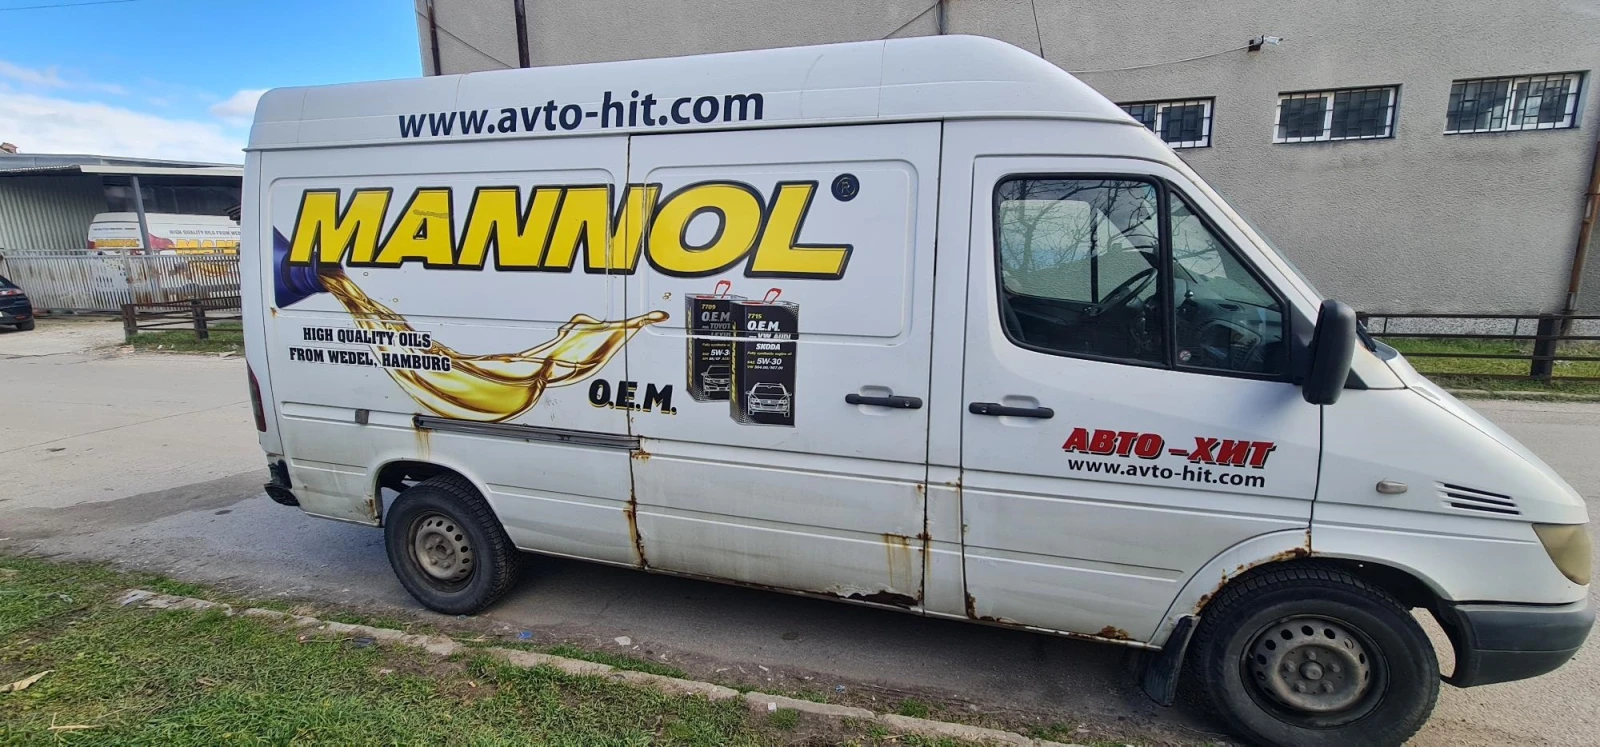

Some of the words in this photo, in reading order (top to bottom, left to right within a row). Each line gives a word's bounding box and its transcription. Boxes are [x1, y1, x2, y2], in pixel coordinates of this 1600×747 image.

[398, 89, 764, 138] www.avto-hit.com
[287, 179, 853, 279] MANNOL
[303, 327, 333, 342] HIGH
[337, 328, 394, 346] QUALITY
[398, 332, 431, 348] OILS
[747, 320, 780, 332] O.E.M.
[289, 347, 324, 363] FROM
[327, 350, 378, 368] WEDEL,
[382, 353, 451, 371] HAMBURG
[588, 378, 677, 415] O.E.M.
[1062, 427, 1164, 459] АВТО
[1068, 458, 1265, 488] www.avto-hit.com
